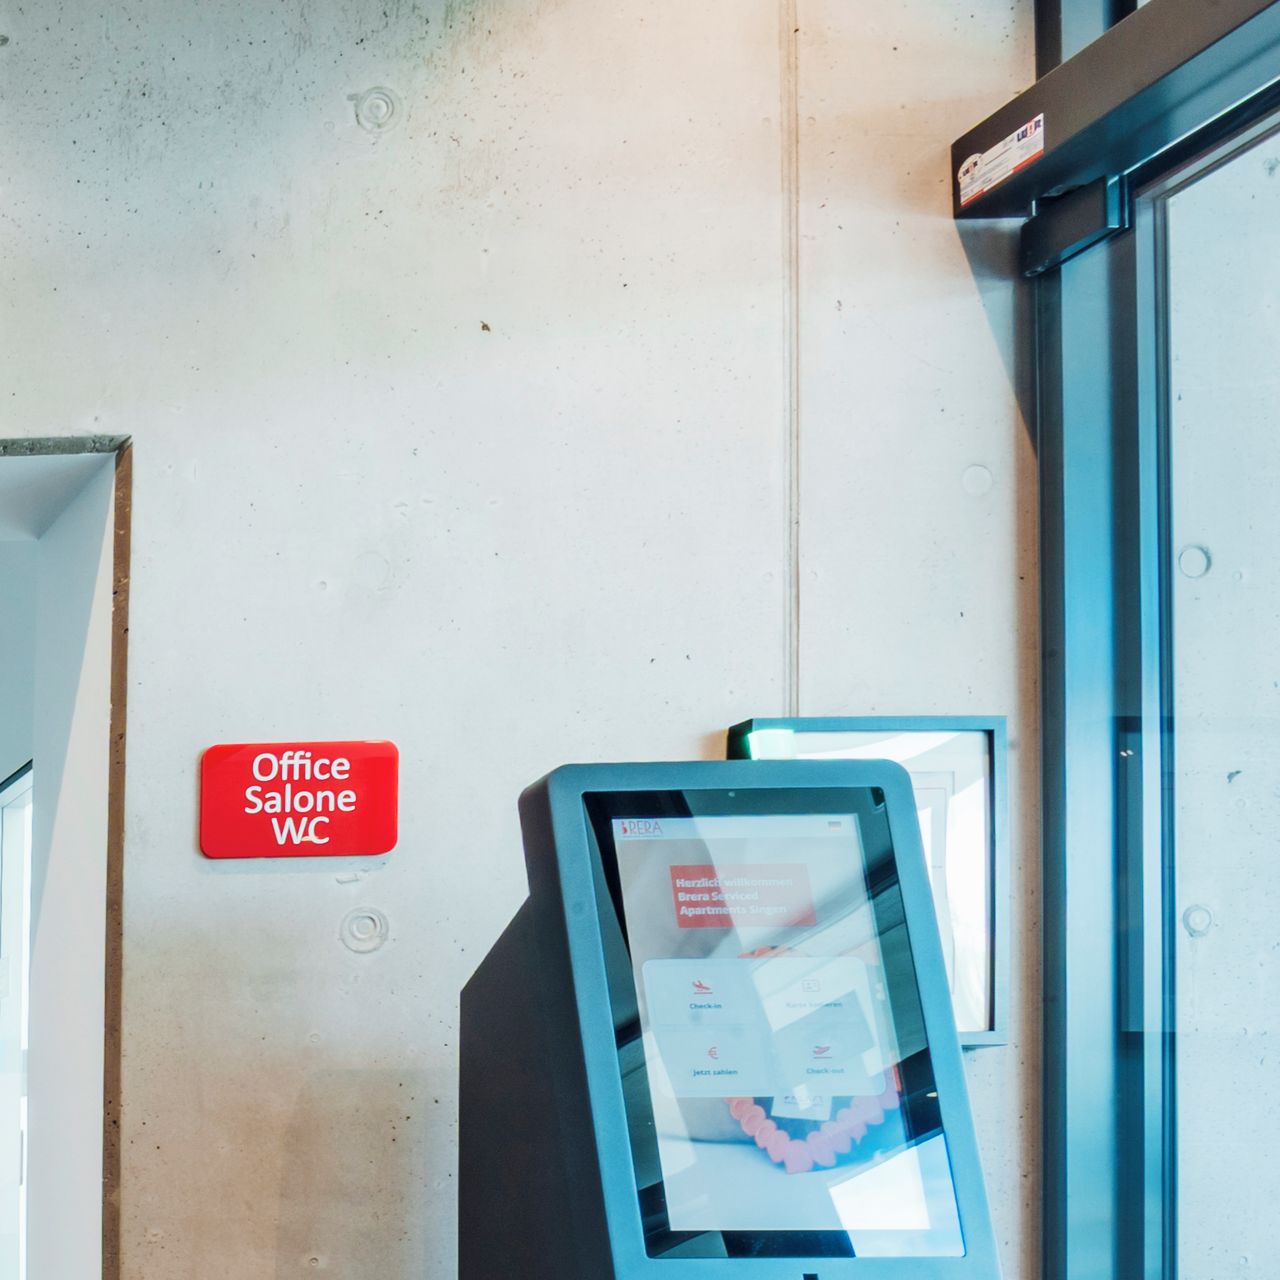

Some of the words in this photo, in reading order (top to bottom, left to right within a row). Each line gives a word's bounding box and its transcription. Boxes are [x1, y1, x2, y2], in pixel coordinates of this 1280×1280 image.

[252, 751, 351, 782] Office
[244, 784, 357, 815] Salone
[271, 816, 330, 845] WC
[675, 878, 720, 888] Herzlich
[723, 878, 793, 888] willkommen
[678, 892, 709, 901] Brera
[712, 891, 759, 901] Serviced
[680, 906, 747, 917] Apartments
